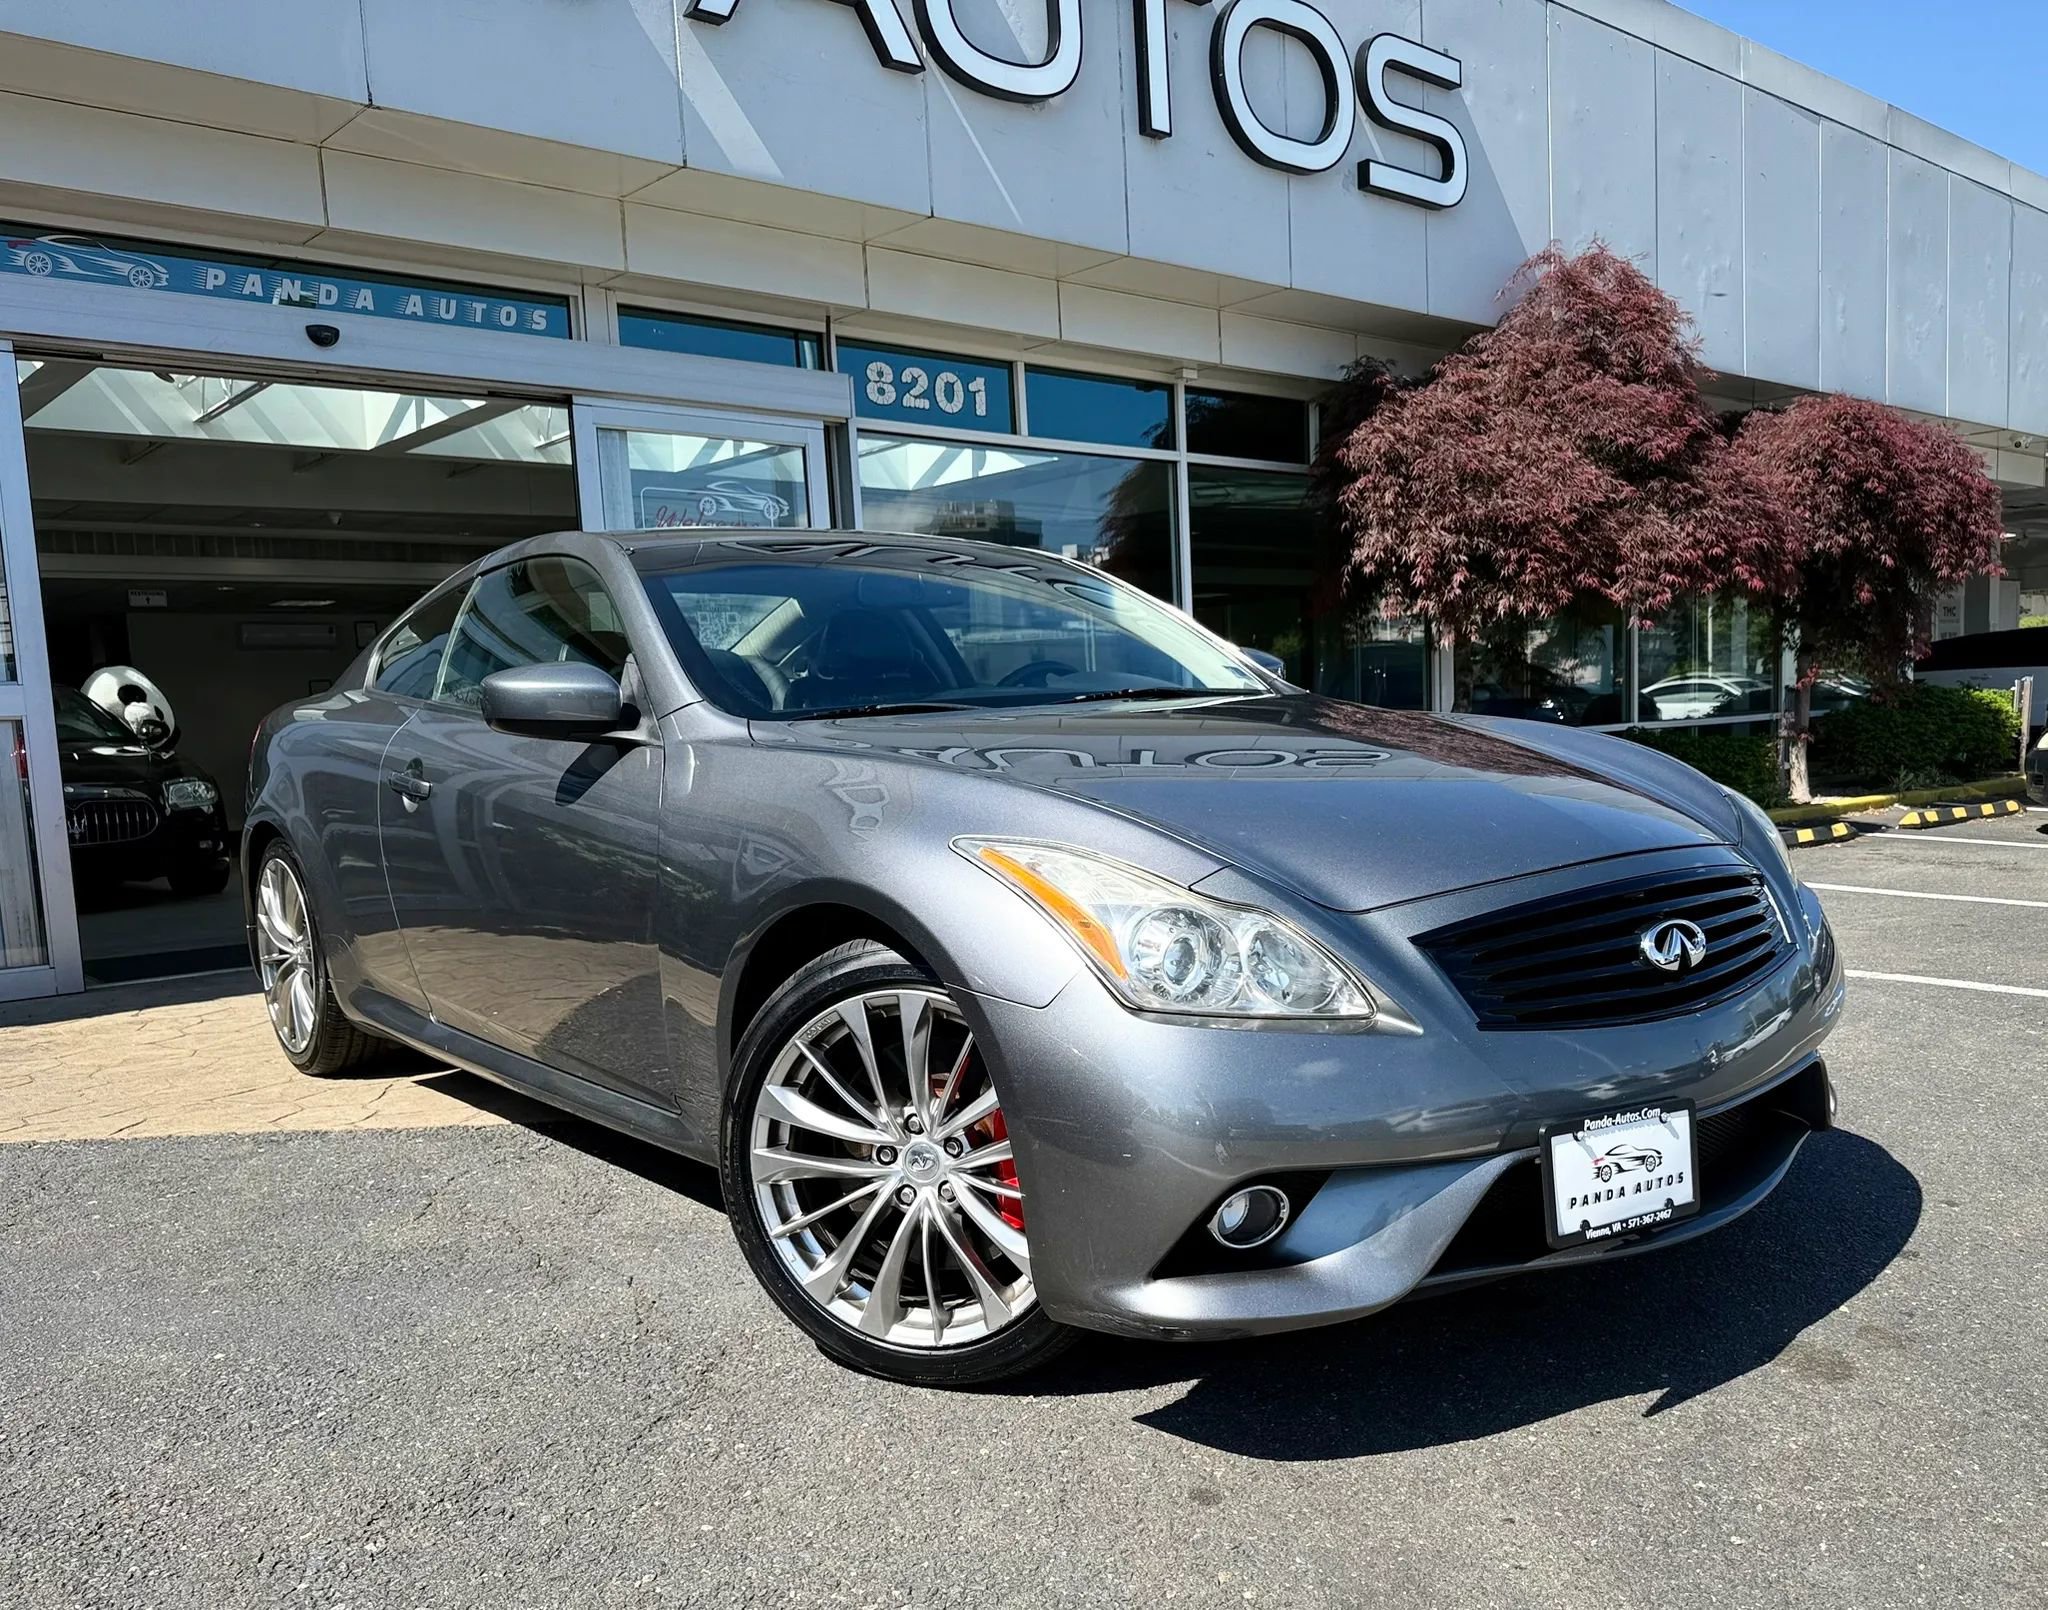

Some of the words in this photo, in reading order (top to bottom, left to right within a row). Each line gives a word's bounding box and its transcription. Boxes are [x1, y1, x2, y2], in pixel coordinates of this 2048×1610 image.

[202, 267, 375, 311] PANDA
[402, 294, 547, 330] AUTOS
[865, 360, 986, 416] 8201
[1584, 1107, 1661, 1131] Panda-Autos.Com
[1568, 1185, 1626, 1209] PANDA
[1634, 1171, 1684, 1194] AUTOS
[1611, 1221, 1622, 1232] VA
